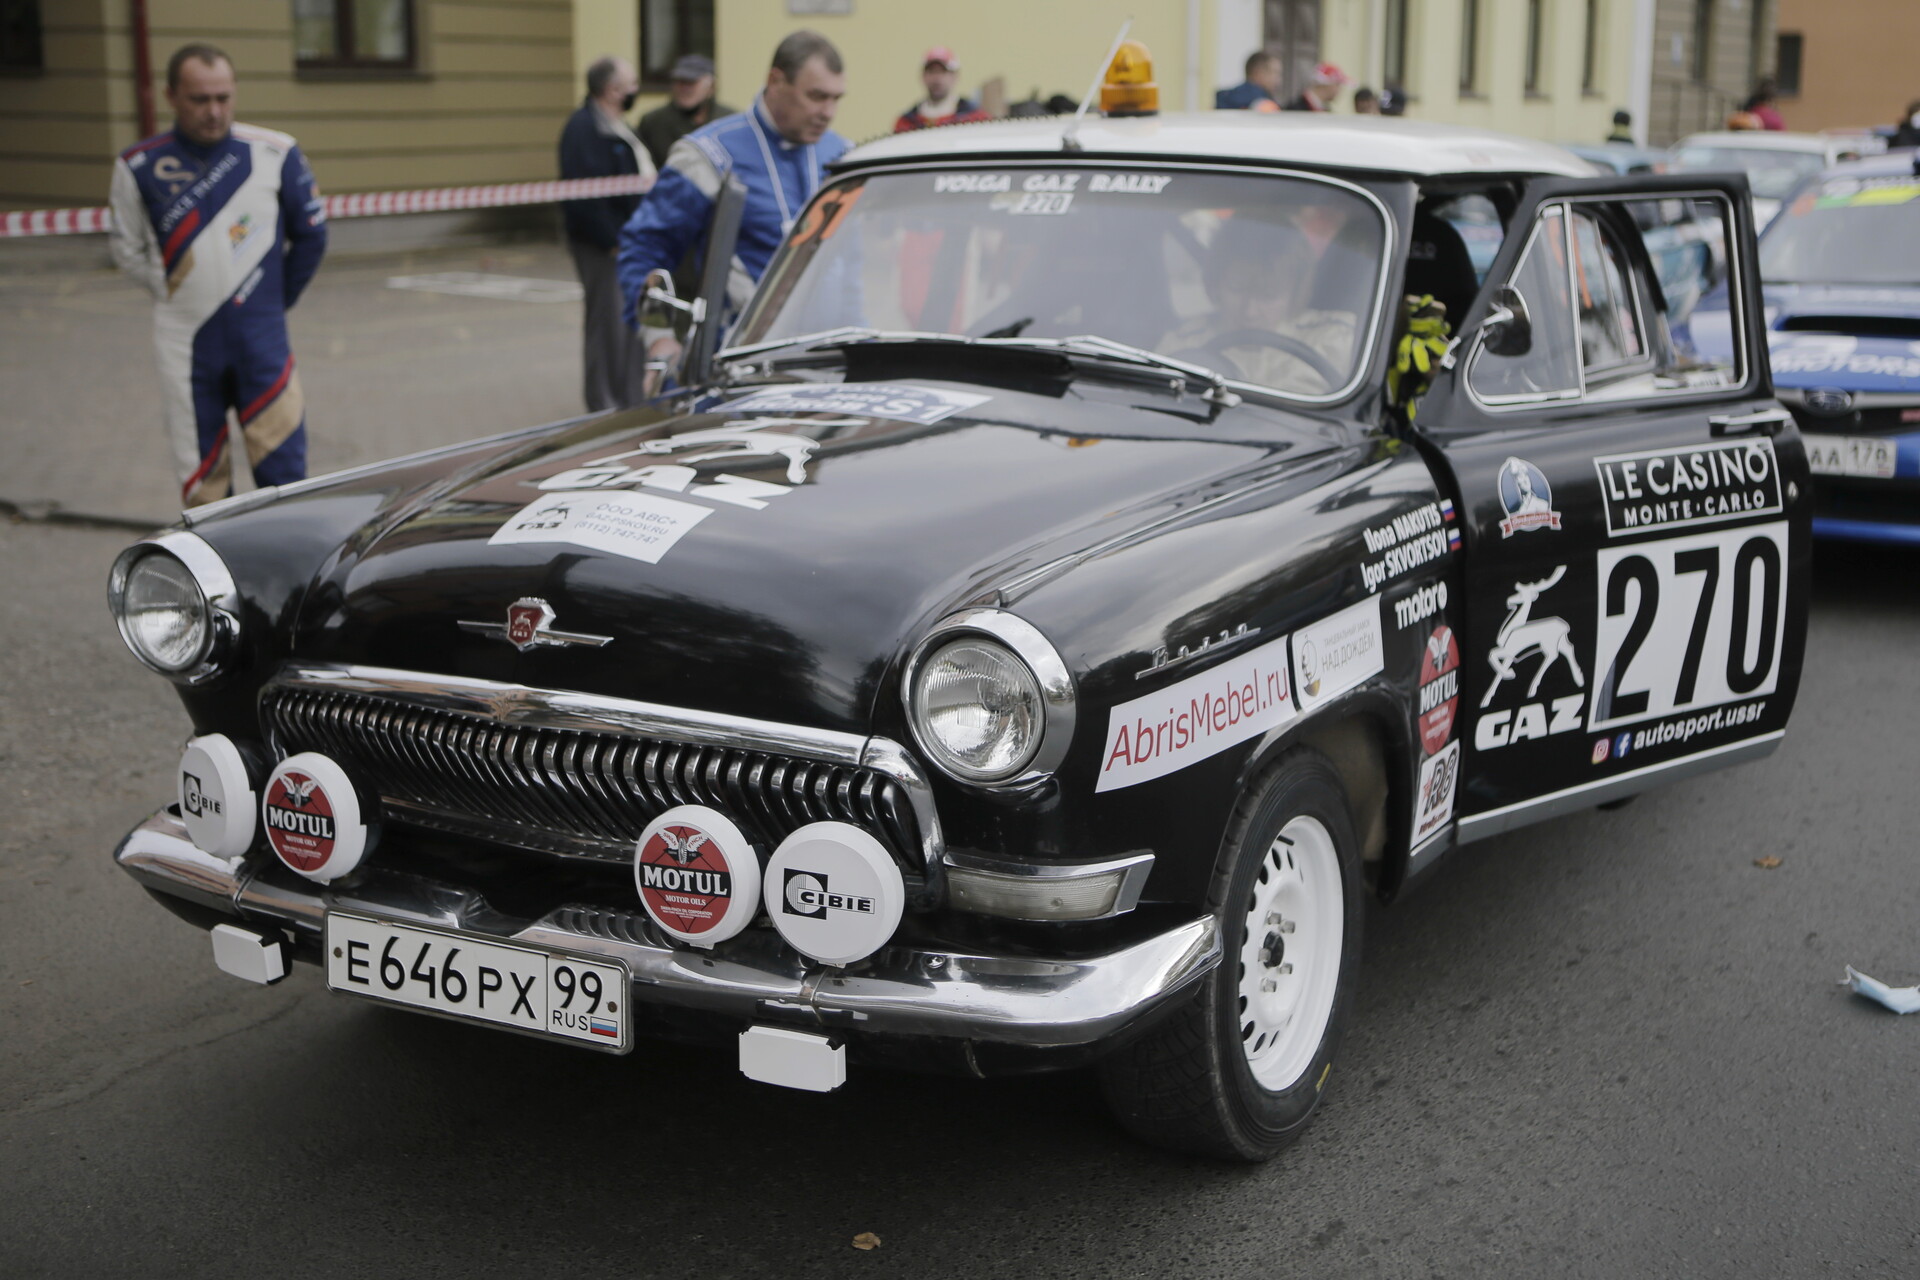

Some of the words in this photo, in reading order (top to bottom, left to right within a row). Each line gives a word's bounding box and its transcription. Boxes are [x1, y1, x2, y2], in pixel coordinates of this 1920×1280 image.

[934, 174, 1012, 193] VOLGA
[1023, 174, 1081, 192] GAZ
[1088, 174, 1173, 194] RALLY
[538, 465, 794, 511] GAZ
[1605, 460, 1643, 502] LE
[1646, 444, 1769, 496] CASINO
[1363, 526, 1397, 554] Ilona
[1392, 502, 1442, 542] NAKUTIS
[1360, 560, 1387, 594] Igor
[1384, 528, 1448, 579] SKVORTSOV
[1597, 535, 1781, 723] 270
[1419, 668, 1459, 716] MOTUL
[1105, 667, 1289, 772] AbrisMebel.ru
[1474, 692, 1586, 752] GAZ
[1632, 701, 1767, 751] autosport.ussr
[269, 806, 333, 839] MOTUL
[643, 865, 728, 896] MOTUL
[665, 894, 690, 905] MOTOR
[690, 897, 707, 906] OILS
[554, 965, 603, 1014] 99
[552, 1010, 589, 1032] RUS
